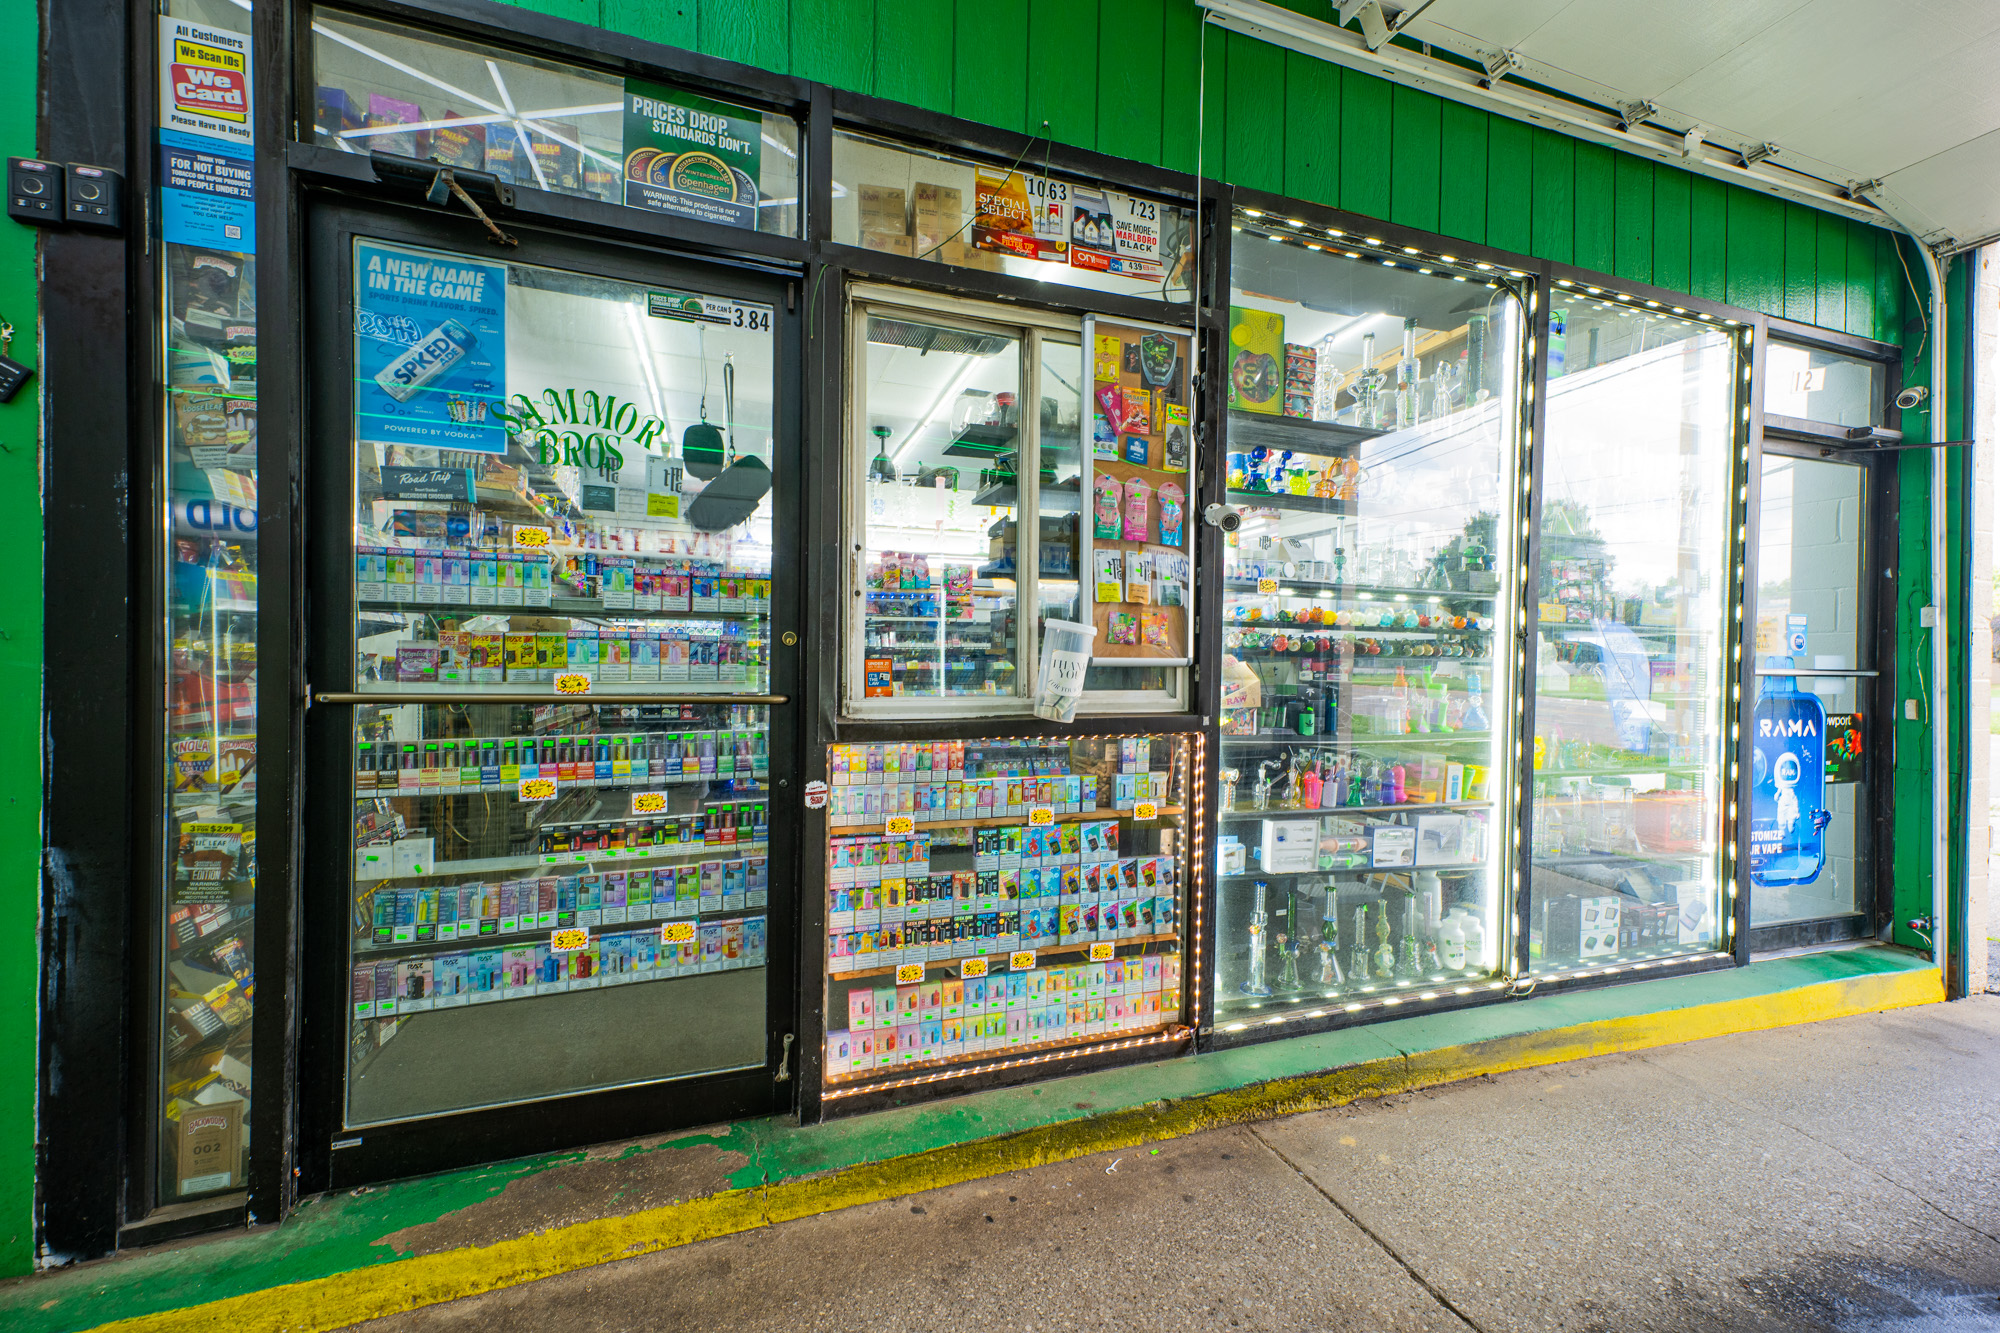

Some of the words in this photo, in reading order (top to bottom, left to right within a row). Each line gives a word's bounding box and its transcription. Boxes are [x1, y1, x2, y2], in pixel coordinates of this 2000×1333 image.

[176, 25, 188, 36] All
[192, 29, 243, 48] Customers
[180, 45, 195, 57] We
[198, 50, 221, 64] Scan
[224, 56, 240, 67] IDs
[185, 68, 231, 88] We
[176, 82, 243, 105] Card
[633, 96, 685, 125] PRICES
[690, 111, 728, 136] DROP.
[171, 115, 196, 126] Please
[199, 120, 216, 130] Have
[218, 123, 227, 132] ID
[229, 126, 250, 138] Ready
[652, 120, 716, 147] STANDARDS
[719, 136, 752, 155] DON'T.
[197, 155, 214, 163] THANK
[676, 156, 708, 173] SATISFACTION
[709, 160, 723, 173] SINCE
[171, 158, 191, 170] FOR
[194, 162, 213, 173] NOT
[215, 166, 251, 180] BUYING
[171, 169, 196, 179] TOBACCO
[206, 175, 223, 183] VAPOR
[224, 178, 251, 188] PRODUCTS
[685, 169, 724, 182] WINTERGREEN
[171, 177, 186, 187] FOR
[188, 180, 215, 191] PEOPLE
[215, 184, 239, 196] UNDER
[240, 189, 252, 197] 21.
[677, 174, 730, 194] Copenhagen
[643, 189, 679, 203] WARNING:
[680, 197, 693, 207] This
[694, 200, 718, 212] product
[719, 204, 724, 213] is
[725, 207, 735, 216] not
[918, 191, 938, 200] RAW
[979, 193, 1029, 211] SPECIAL
[647, 199, 661, 208] safe
[662, 202, 695, 214] alternative
[696, 207, 703, 215] to
[704, 210, 736, 223] cigarettes.
[981, 203, 1027, 221] SELECT
[1129, 198, 1155, 221] 7.23
[1116, 220, 1133, 231] SAVE
[1133, 223, 1152, 236] MORE
[1002, 238, 1023, 248] FILTER
[1116, 230, 1157, 246] MARLBORO
[1120, 240, 1152, 253] BLACK
[367, 255, 382, 272] A
[385, 258, 430, 279] NEW
[432, 266, 486, 287] NAME
[368, 272, 390, 290] IN
[394, 276, 427, 295] THE
[429, 282, 483, 303] GAME
[369, 291, 400, 303] SPORTS
[402, 296, 428, 307] DRINK
[430, 300, 466, 312] FLAVORS.
[469, 305, 499, 316] SPIKED.
[705, 303, 716, 311] PER
[717, 305, 728, 313] CAN
[733, 308, 770, 332] 3.84
[438, 347, 460, 367] ADE
[490, 388, 665, 450] SAMMOR
[384, 424, 428, 435] POWERED
[444, 430, 476, 439] VODKA
[535, 429, 624, 471] BROS
[400, 473, 428, 485] Road
[430, 470, 452, 484] Trip
[1226, 695, 1247, 706] RAW
[1760, 719, 1817, 737] RAMA
[180, 740, 209, 752] NOLA
[1762, 843, 1783, 854] VAPE
[193, 870, 221, 880] EDITION
[174, 908, 189, 921] LEAF
[188, 1116, 227, 1135] BACKWOODS
